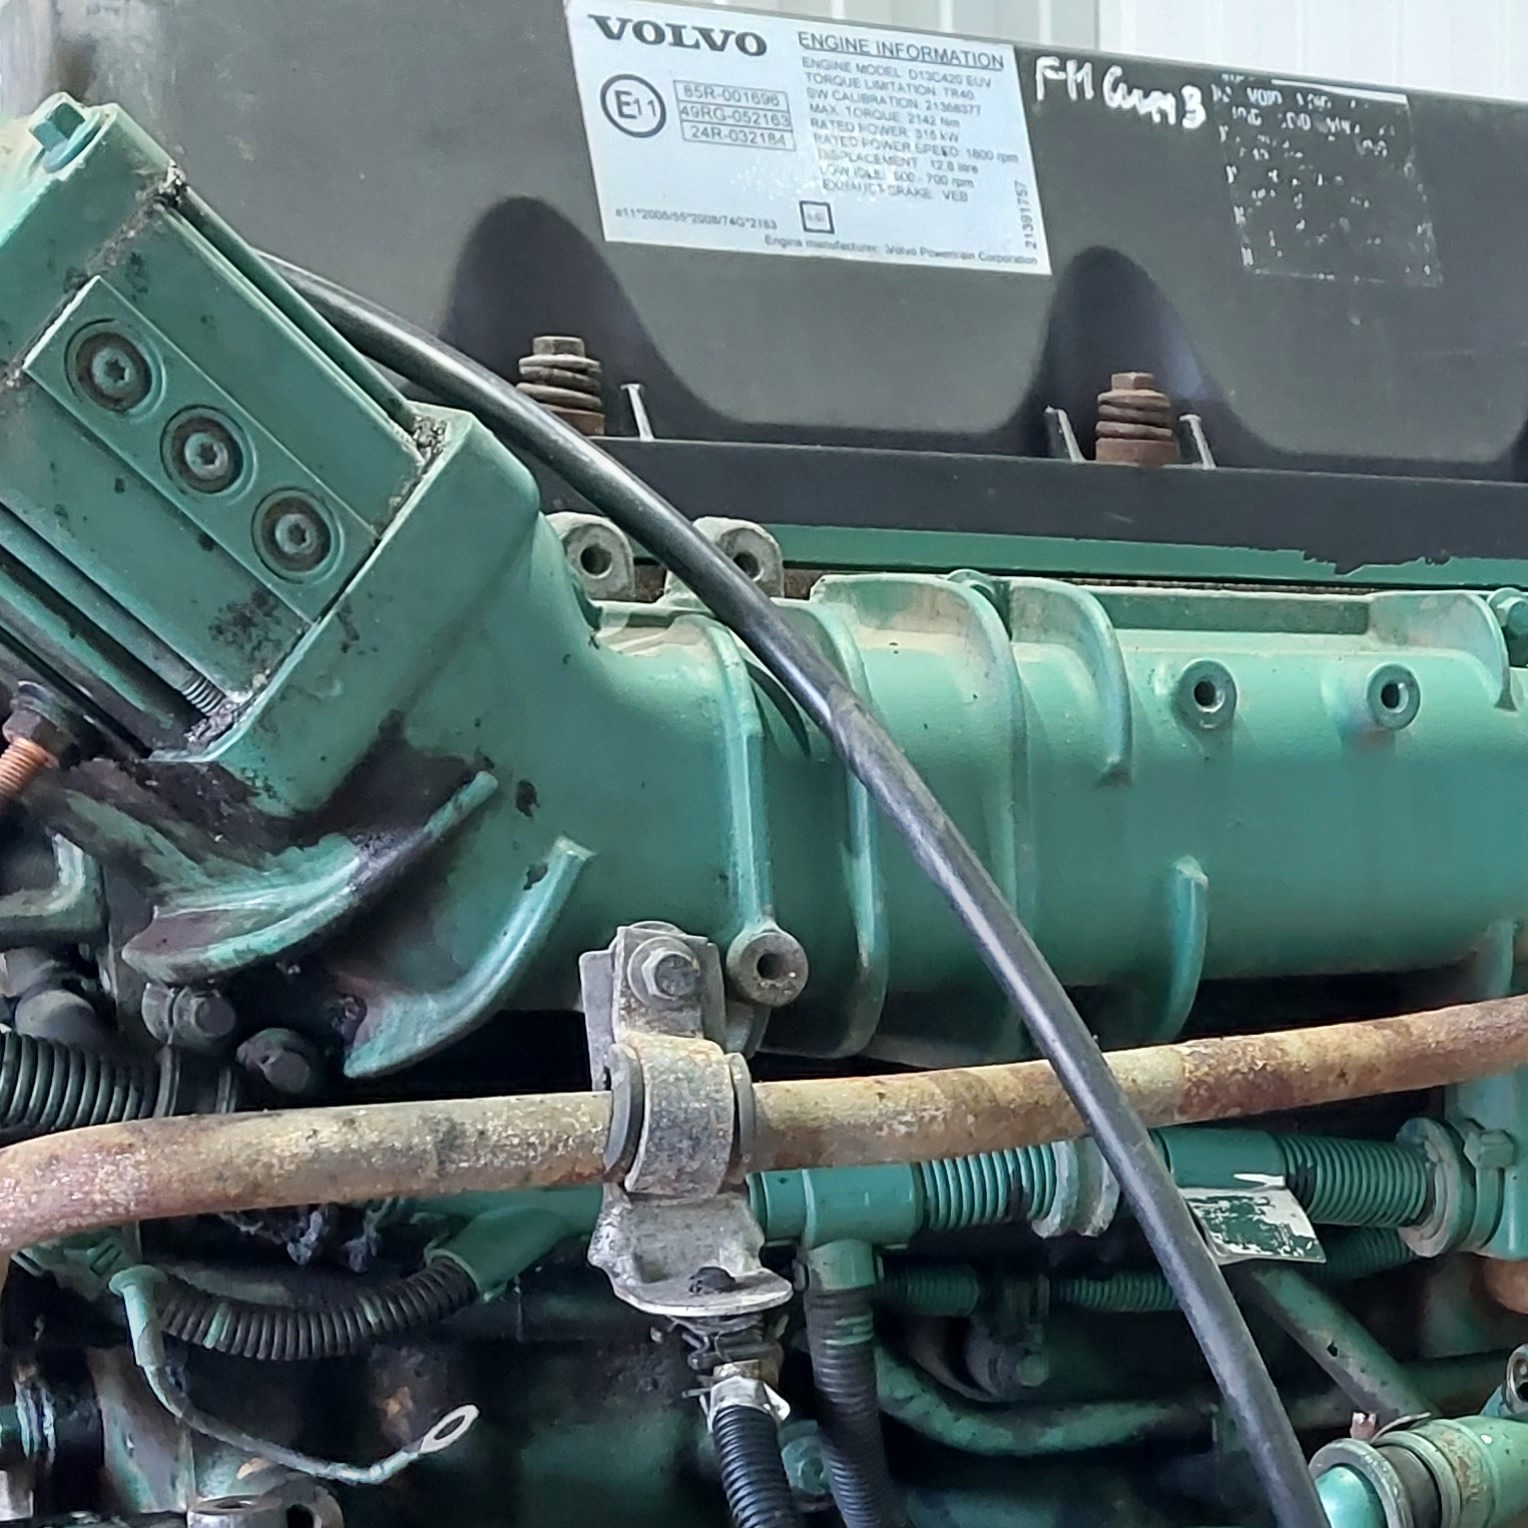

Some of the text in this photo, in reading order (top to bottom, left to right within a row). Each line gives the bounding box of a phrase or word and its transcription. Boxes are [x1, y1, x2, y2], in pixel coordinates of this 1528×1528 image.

[588, 15, 767, 56] VOLVO
[798, 31, 1004, 69] ENGINE INFORMATION
